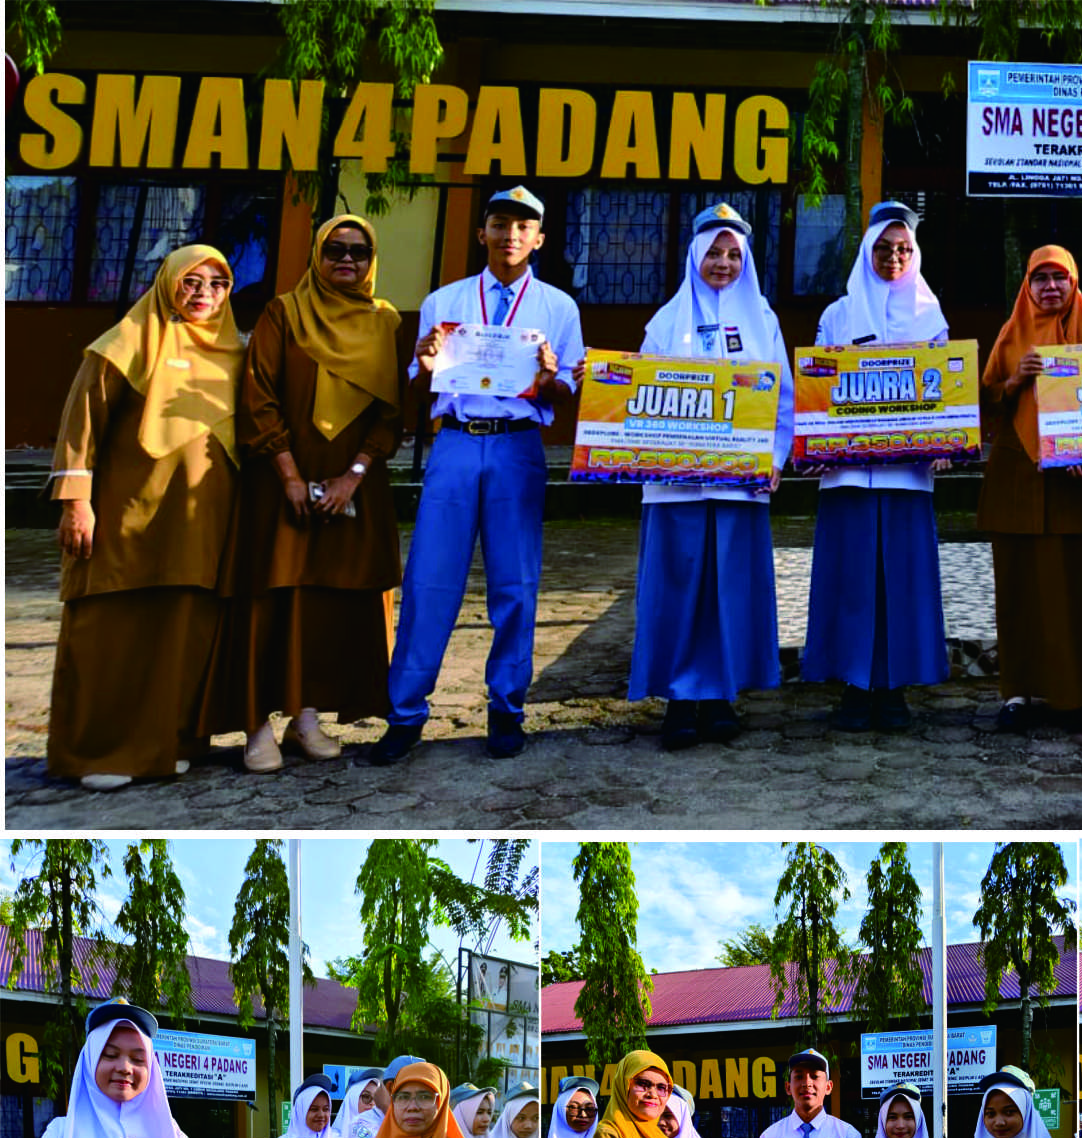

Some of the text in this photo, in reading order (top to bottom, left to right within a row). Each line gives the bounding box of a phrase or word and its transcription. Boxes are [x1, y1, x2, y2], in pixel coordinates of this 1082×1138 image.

[1007, 72, 1060, 84] PEMERINTAH
[1053, 87, 1078, 97] DINAS
[982, 107, 1024, 137] SMA
[831, 368, 943, 404] JUARA 2
[627, 384, 737, 421] JUARA 1
[836, 403, 937, 415] CODING WORKSHOP
[667, 421, 729, 433] WORKSHOP
[164, 1055, 248, 1075] NEGERI 4 PADANG
[867, 1054, 889, 1070] SMA
[892, 1052, 931, 1069] NEGERI
[165, 1070, 214, 1080] TERAKREDITASI
